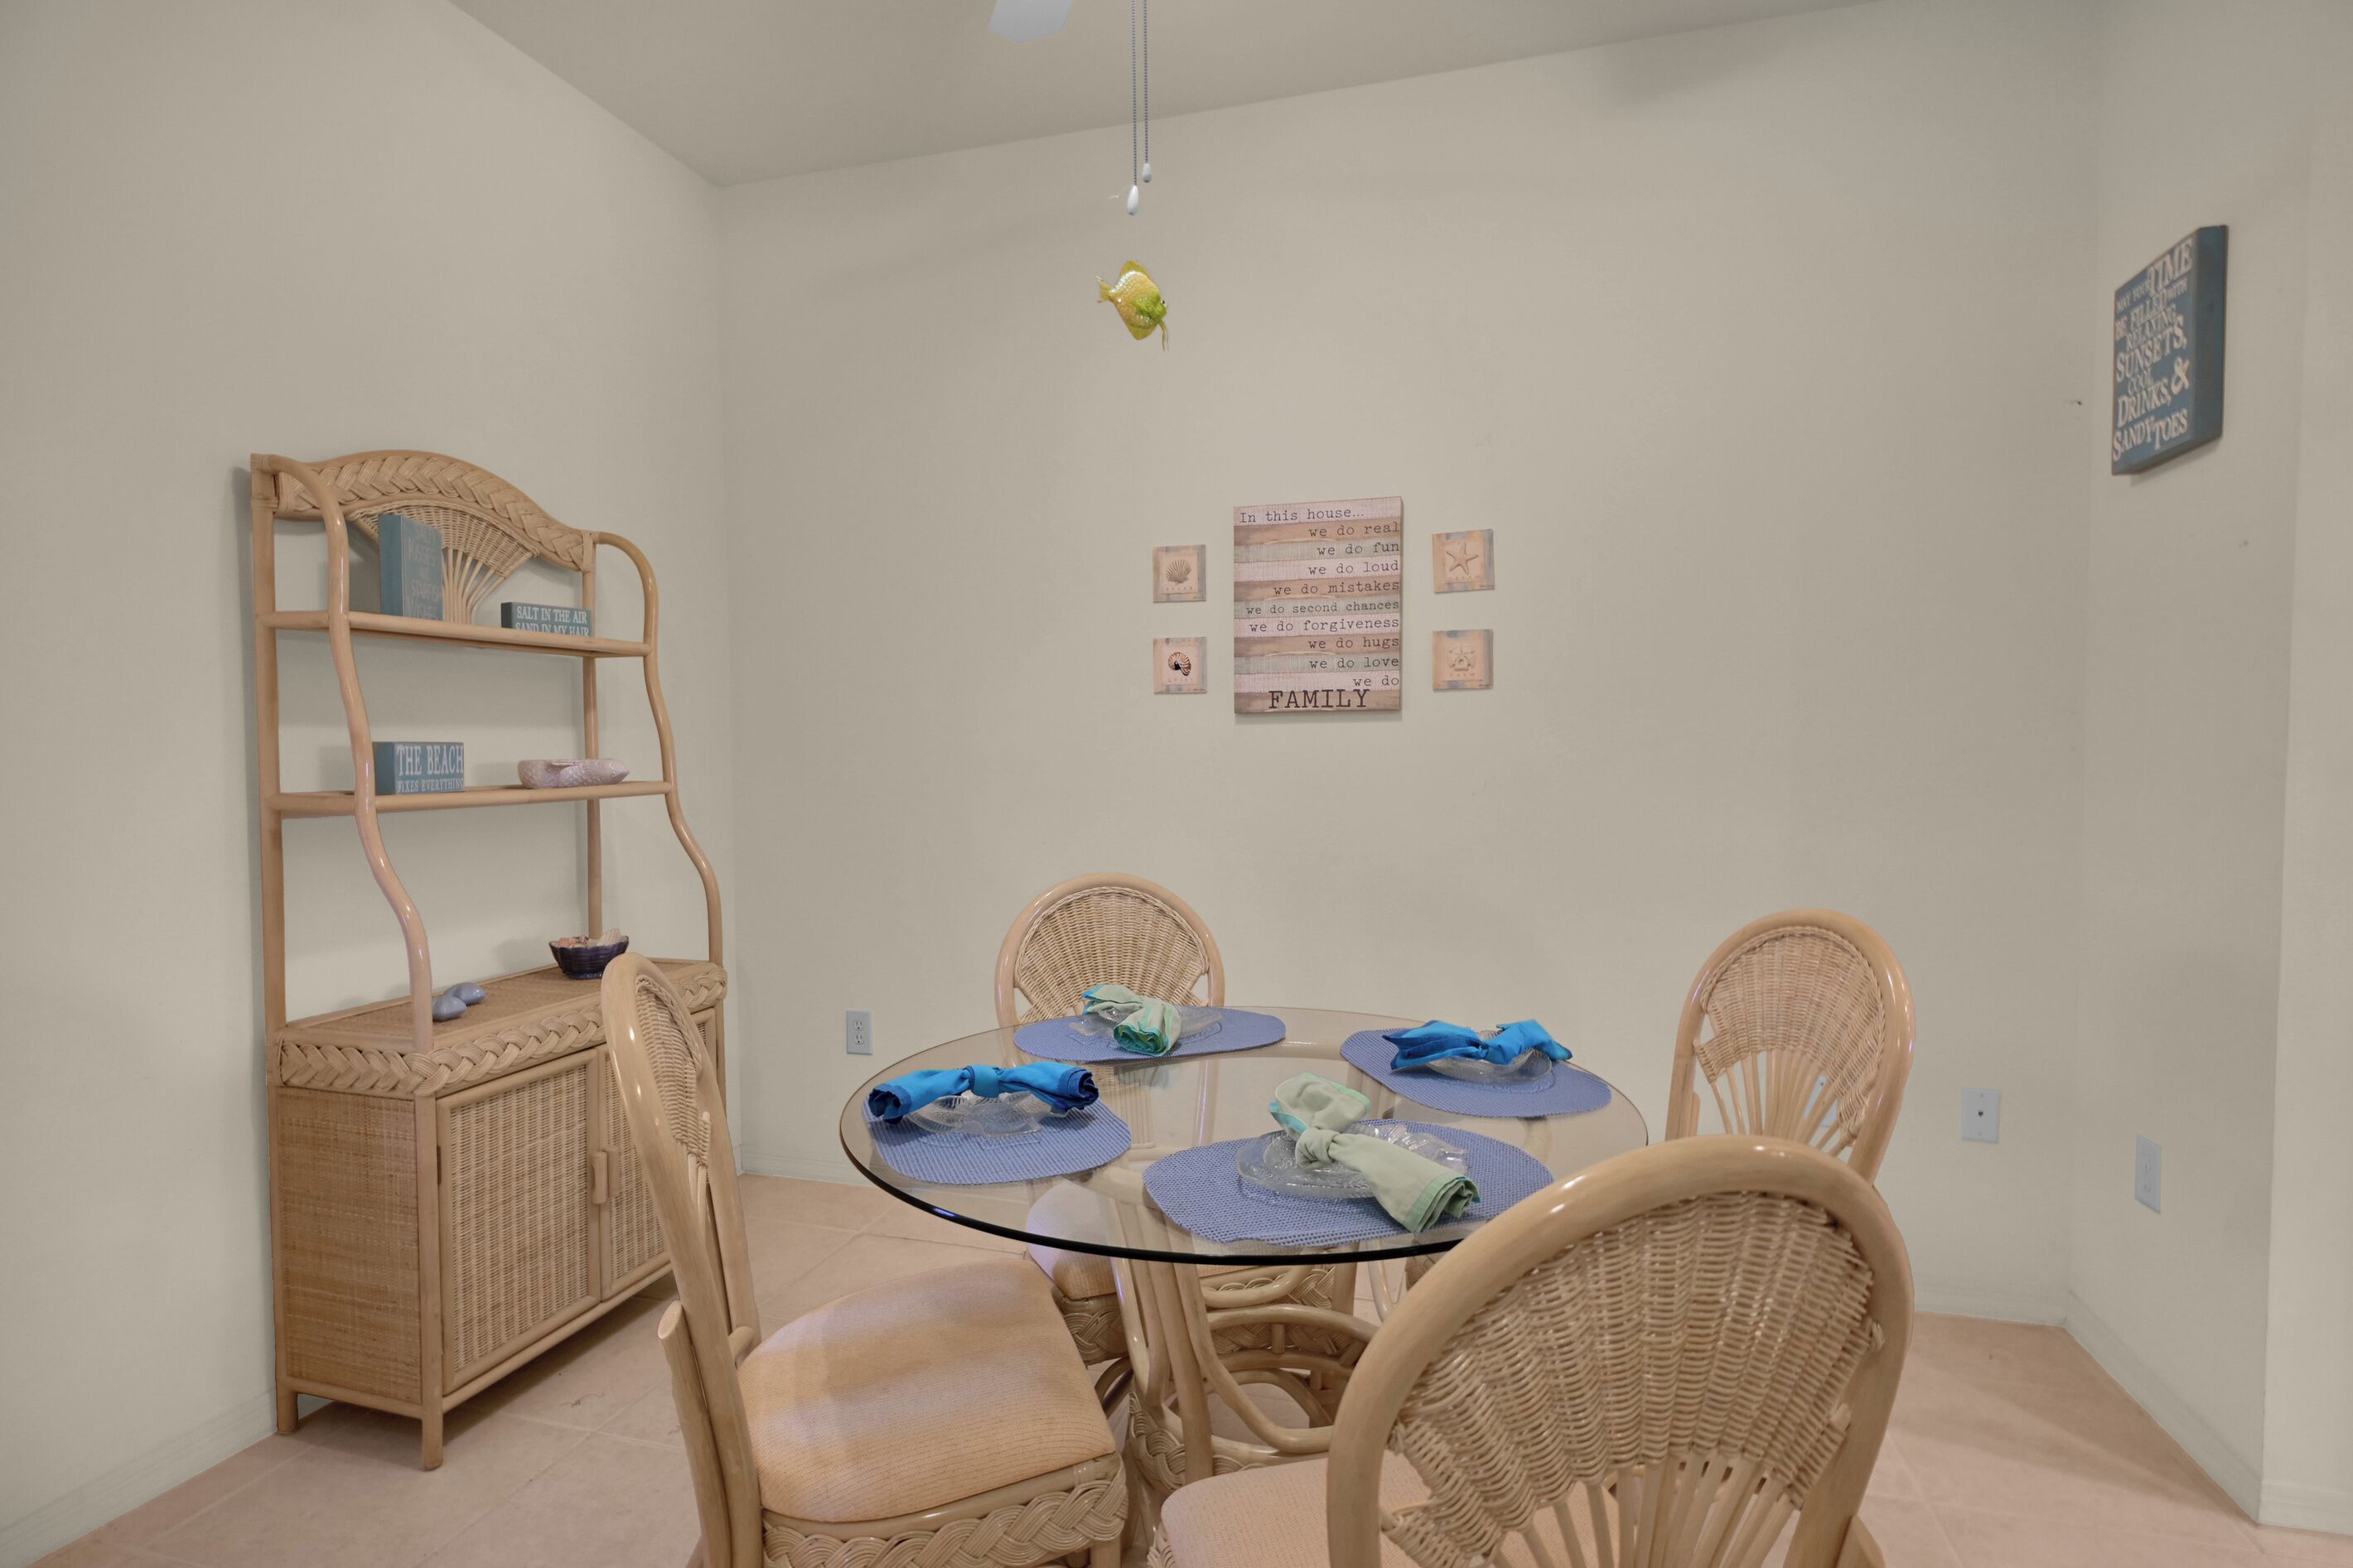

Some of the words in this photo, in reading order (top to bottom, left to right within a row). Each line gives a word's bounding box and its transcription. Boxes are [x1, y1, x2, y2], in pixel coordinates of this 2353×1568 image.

[2148, 237, 2193, 293] TIME
[2130, 289, 2167, 330] FILLED
[2116, 314, 2187, 383] SUNSETS,
[2128, 367, 2154, 395] COOL
[2118, 377, 2172, 428] DRINKS,
[2171, 356, 2190, 395] &
[2113, 415, 2155, 461] SANDY
[2154, 407, 2188, 451] TOES
[1239, 512, 1256, 523] In
[1265, 510, 1298, 522] this
[1307, 508, 1364, 519] house...
[1308, 528, 1326, 537] we
[1336, 525, 1355, 536] do
[1364, 521, 1400, 534] real
[1317, 546, 1335, 556] we
[1345, 543, 1363, 554] do
[1373, 542, 1399, 553] fun
[1308, 566, 1326, 575] we
[1336, 562, 1354, 574] do
[1363, 560, 1399, 572] loud
[1273, 586, 1292, 596] we
[1301, 583, 1318, 594] do
[1327, 580, 1399, 594] mistakes
[516, 605, 539, 620] SALT
[540, 608, 551, 621] IN
[553, 609, 570, 623] THE
[573, 610, 587, 624] AIR
[1246, 606, 1261, 615] we
[1269, 605, 1285, 614] do
[1292, 602, 1337, 614] second
[1346, 600, 1399, 611] chances
[515, 622, 539, 632] SAND
[540, 623, 552, 634] IN
[553, 625, 568, 634] MY
[568, 626, 589, 636] HAIR
[1249, 623, 1268, 632] we
[1277, 620, 1294, 631] do
[1303, 618, 1399, 632] forgiveness
[1308, 639, 1326, 649] we
[1336, 637, 1353, 649] do
[1362, 636, 1399, 649] hugs
[1310, 659, 1327, 668] we
[1337, 658, 1355, 668] do
[1364, 656, 1399, 667] love
[1353, 678, 1372, 687] we
[1381, 675, 1399, 686] do
[1268, 688, 1370, 709] FAMILY
[397, 745, 422, 776] THE
[427, 745, 464, 774] BEACH
[398, 780, 419, 793] FIXES
[421, 778, 464, 792] EVERYTHING
